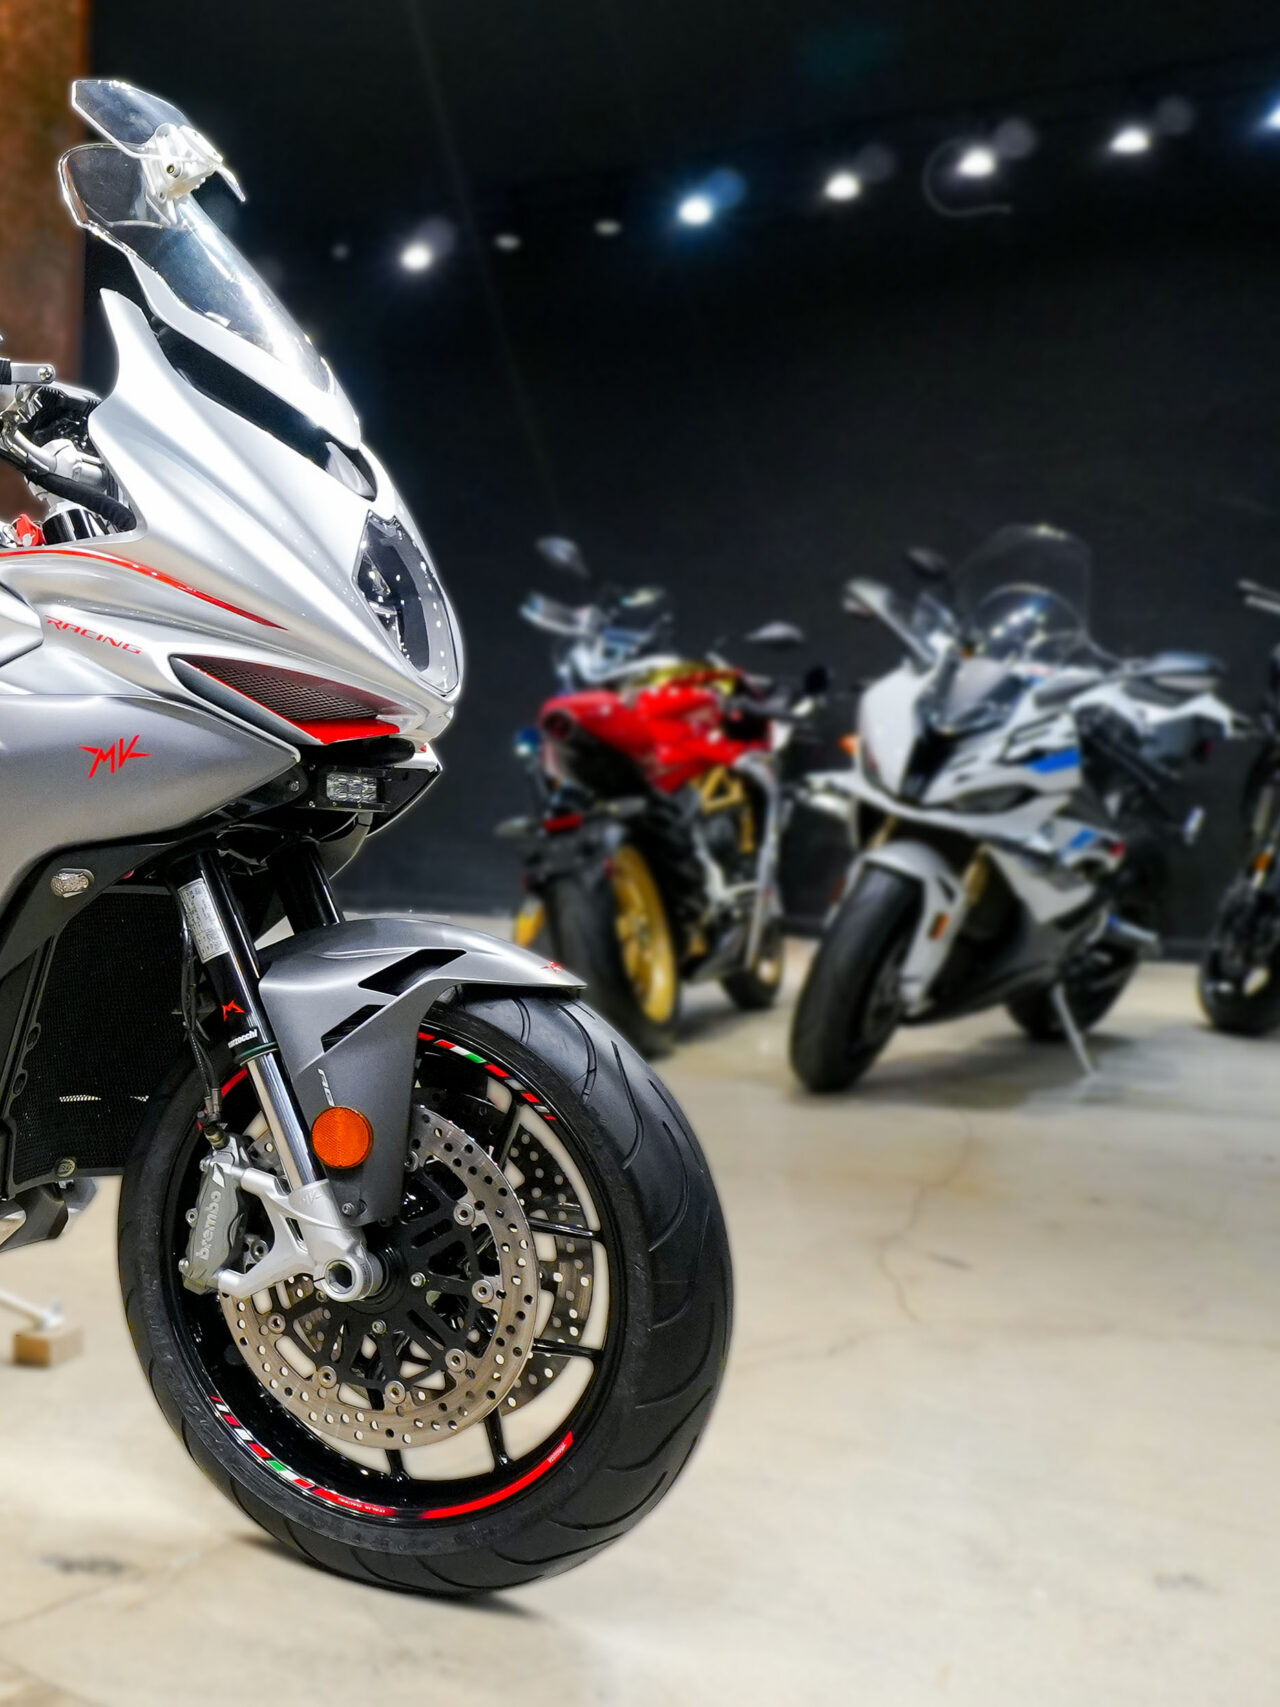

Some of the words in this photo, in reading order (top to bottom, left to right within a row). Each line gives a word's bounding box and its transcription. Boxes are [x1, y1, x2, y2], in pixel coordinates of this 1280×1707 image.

[44, 615, 143, 655] RACING
[78, 734, 152, 778] MV
[195, 1190, 222, 1261] brembo
